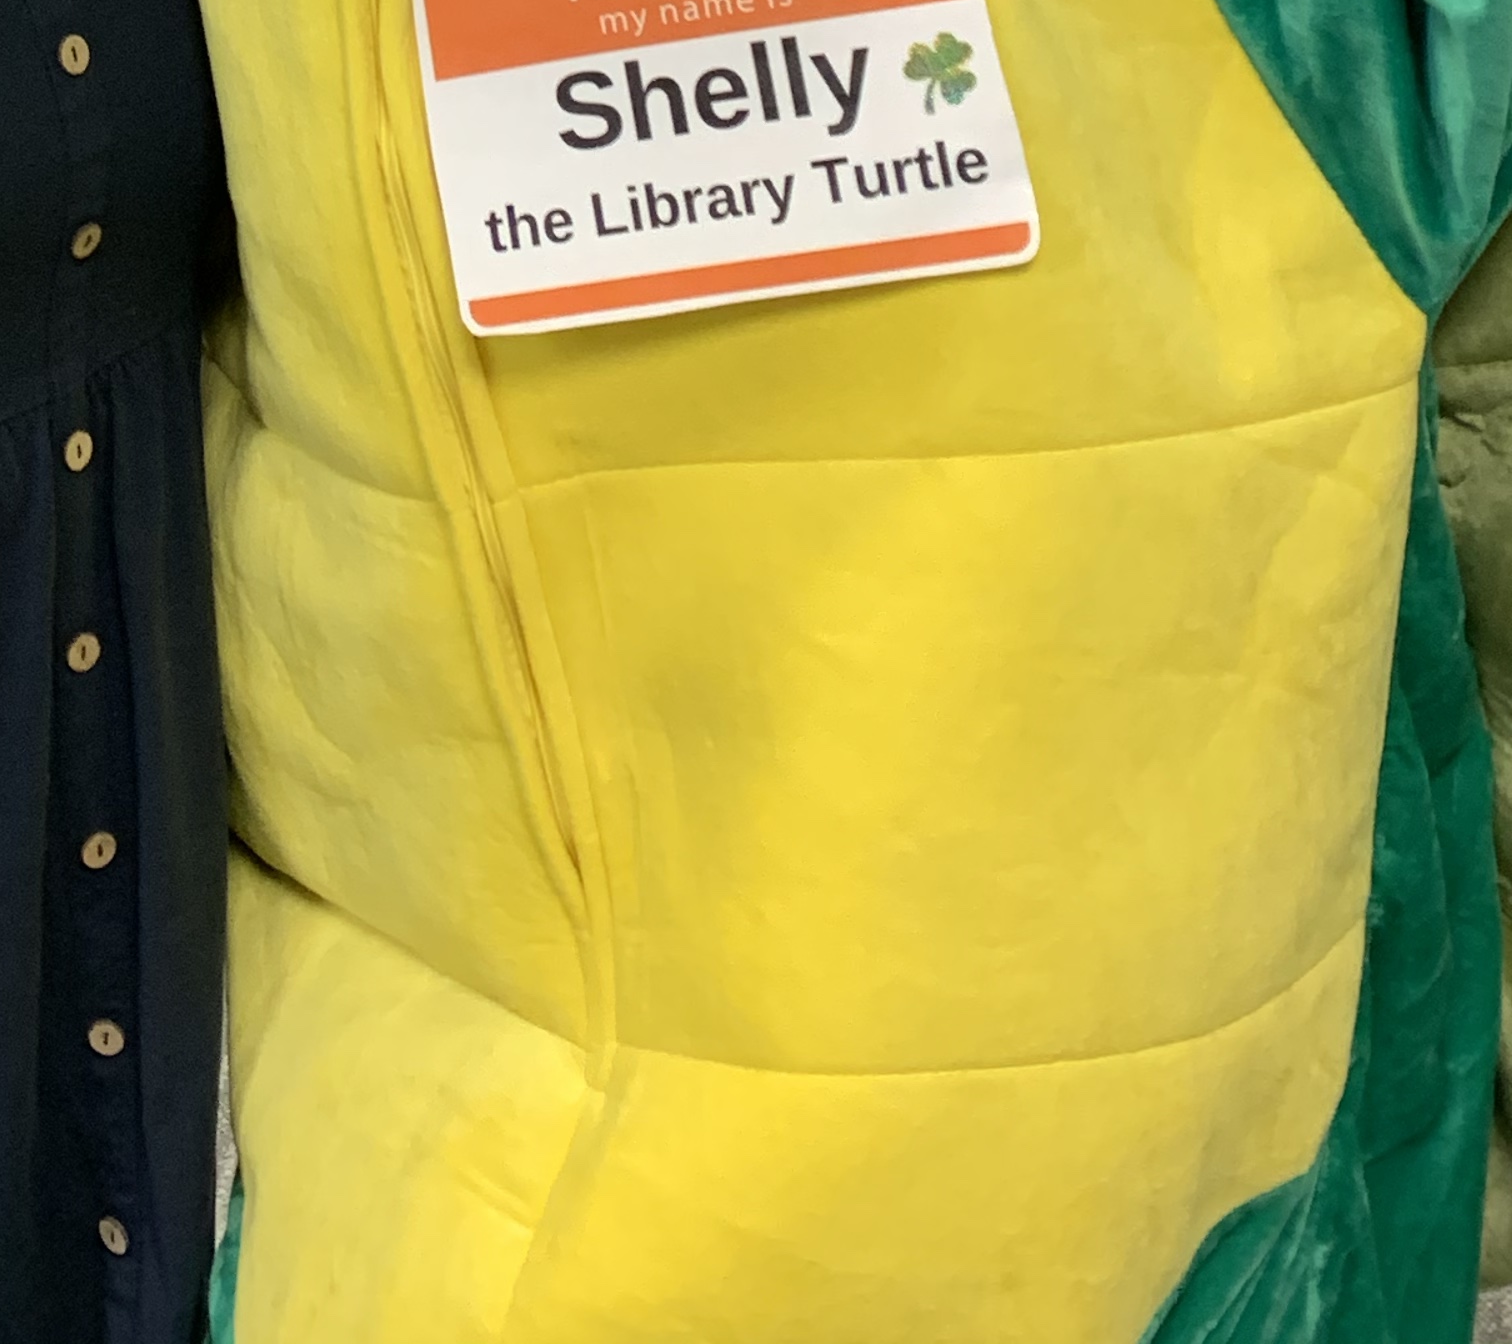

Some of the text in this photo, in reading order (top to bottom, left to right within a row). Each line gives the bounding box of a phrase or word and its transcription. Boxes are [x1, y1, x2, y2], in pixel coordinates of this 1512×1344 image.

[599, 8, 648, 37] my
[555, 36, 869, 150] Shelly
[484, 140, 989, 253] the Library Turtle
